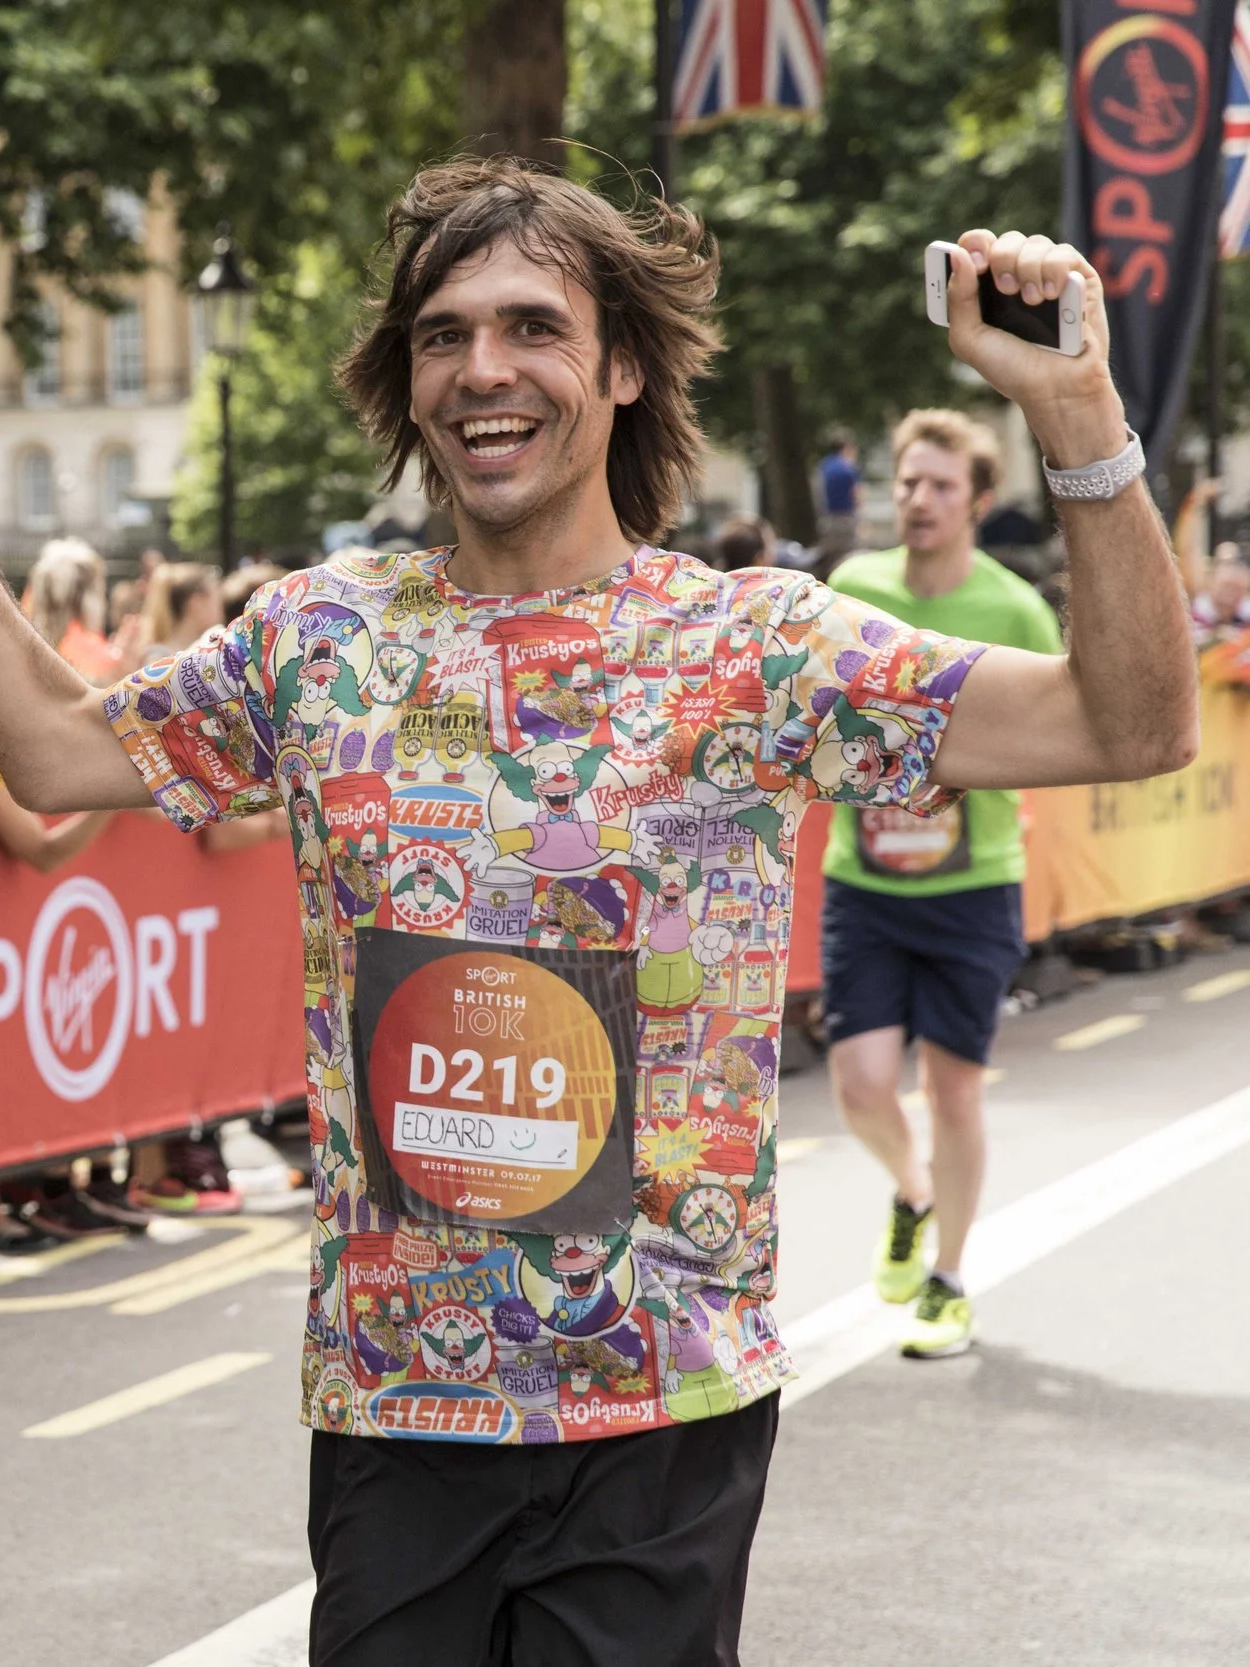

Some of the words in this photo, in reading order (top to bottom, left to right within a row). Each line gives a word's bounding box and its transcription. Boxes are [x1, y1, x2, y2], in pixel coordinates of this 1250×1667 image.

[1072, 0, 1209, 304] SPO
[448, 648, 467, 662] IT'S
[469, 646, 476, 656] A
[440, 658, 486, 680] BLAST!
[680, 697, 716, 708] USES!
[400, 712, 436, 730] ACID
[440, 711, 479, 732] ACID
[680, 709, 712, 720] 1,001
[398, 728, 435, 739] SULFURIC
[439, 729, 477, 740] SULFURIC
[589, 770, 684, 823] Krusty
[324, 801, 387, 830] KrustyO's
[401, 847, 452, 868] STUFF
[396, 902, 455, 924] KRUSTY
[471, 904, 528, 918] IMITATION
[468, 915, 529, 937] GRUEL
[466, 966, 516, 986] SPORT
[454, 988, 526, 1009] BRITISH
[453, 1005, 525, 1040] 10K
[409, 1042, 566, 1108] D219
[401, 1111, 494, 1149] EDUARD
[421, 1160, 495, 1178] WESTMINSTER
[500, 1170, 541, 1183] 09.07.17
[470, 1195, 501, 1209] asics
[349, 1262, 408, 1291] KrustyO's
[411, 1264, 512, 1309] KRUSTY
[426, 1308, 480, 1330] KRUSTY
[498, 1308, 537, 1326] CHICKS
[501, 1318, 519, 1331] DIG
[433, 1363, 482, 1382] STUFF
[501, 1363, 555, 1377] IMITATION
[500, 1375, 558, 1395] GRUEL
[378, 1397, 506, 1433] KRUSTY
[561, 1396, 655, 1425] KrustyO's
